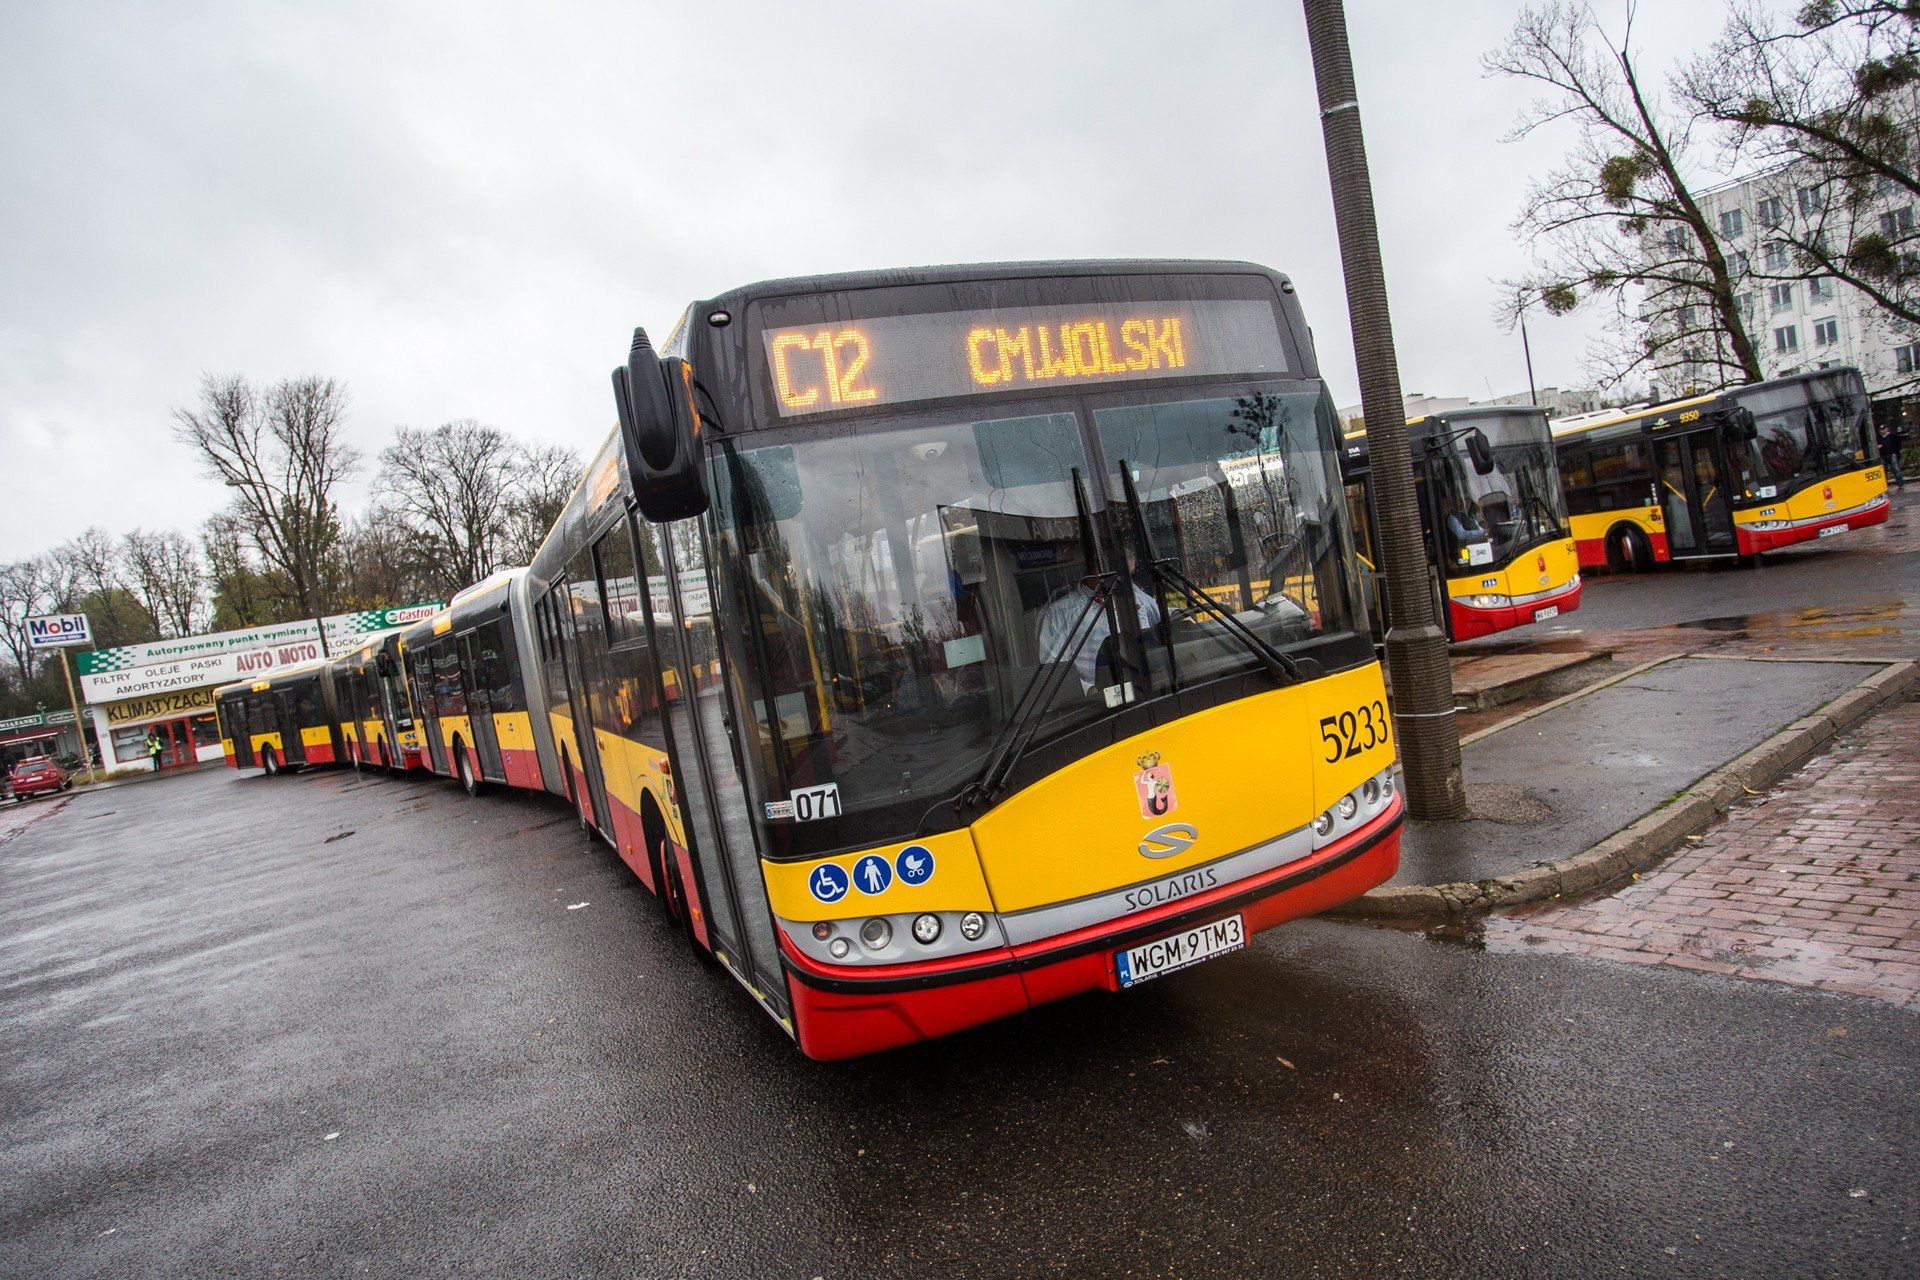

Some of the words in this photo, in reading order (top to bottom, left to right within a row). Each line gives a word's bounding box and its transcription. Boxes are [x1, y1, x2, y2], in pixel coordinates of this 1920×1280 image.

[771, 327, 878, 407] C12
[1679, 410, 1699, 424] 9350
[29, 617, 85, 636] Mobil
[399, 607, 434, 621] Castrol
[147, 640, 224, 657] Autoryzowany
[228, 634, 259, 646] punkt
[263, 626, 308, 640] wymiany
[93, 673, 131, 685] FILTRY
[145, 665, 180, 677] OLEJE
[191, 659, 222, 670] PASKI
[237, 651, 273, 672] AUTO
[278, 644, 317, 665] MOTO
[116, 673, 205, 694] AMORTYZATORY
[1320, 700, 1388, 763] 5233
[796, 789, 841, 821] 071
[1124, 868, 1218, 912] SOLARIS
[1132, 938, 1182, 975] WGM
[1187, 919, 1241, 957] 9TM3
[1120, 970, 1130, 979] PL
[1133, 973, 1158, 985] SOLARIS
